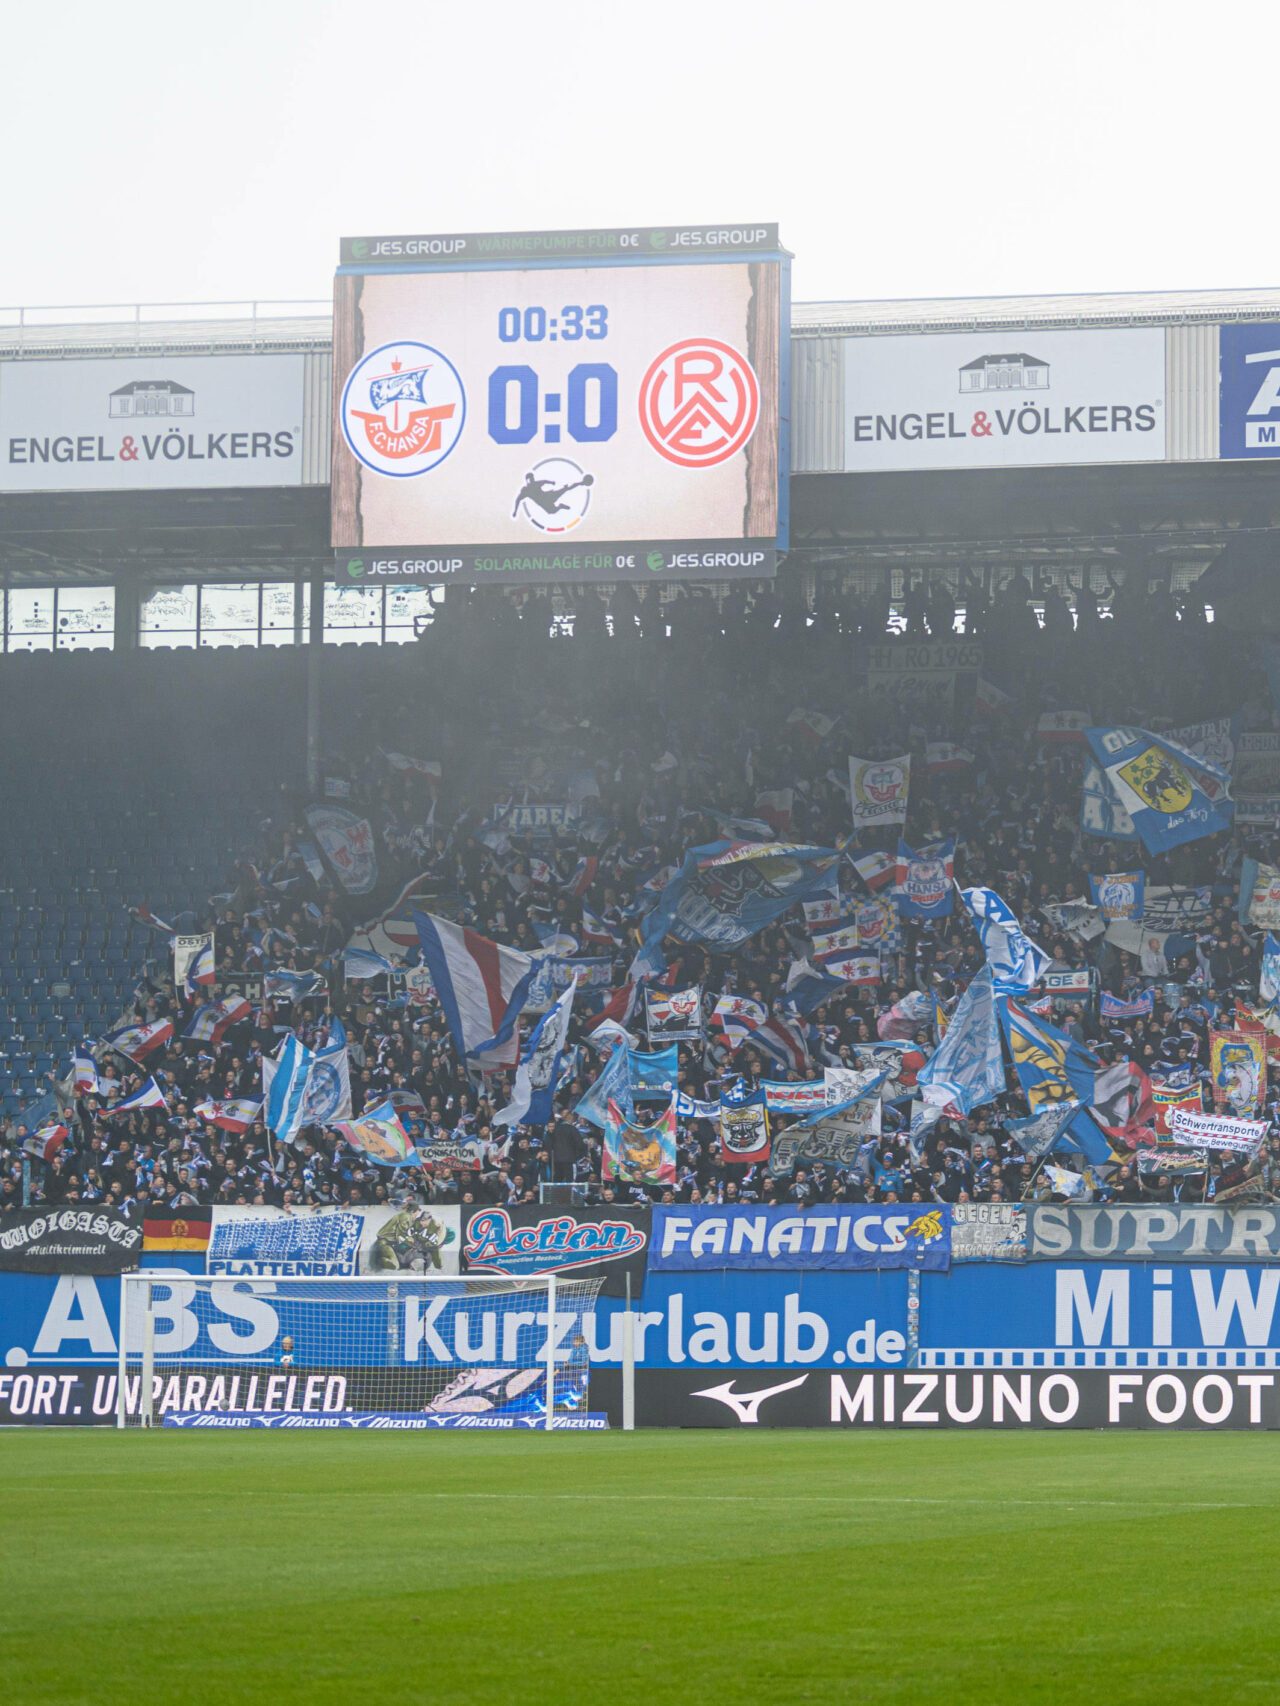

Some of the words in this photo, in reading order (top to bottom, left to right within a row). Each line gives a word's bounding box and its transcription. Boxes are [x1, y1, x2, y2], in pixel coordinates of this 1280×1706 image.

[370, 239, 467, 256] JES.GROUP
[587, 231, 617, 248] FÜR
[619, 233, 639, 248] 0€
[670, 229, 768, 247] JES.GROUP
[498, 304, 609, 343] 00:33
[488, 362, 619, 446] 0:0
[367, 558, 464, 576] JES.GROUP
[473, 555, 582, 572] SOLARANLAGE
[584, 552, 613, 569] FÜR
[615, 554, 636, 569] 0€
[666, 551, 765, 569] JES.GROUP
[1175, 1113, 1261, 1137] Schwertransporte
[1196, 1136, 1209, 1146] der
[954, 1204, 1013, 1225] GEGEN
[25, 1244, 106, 1256] Multikriminell
[466, 1208, 645, 1262] Action
[661, 1213, 912, 1257] FANATICS
[210, 1261, 353, 1276] PLATTENBAU
[403, 1292, 904, 1364] Kurzurlaub.de
[92, 1374, 354, 1416] UNPARALLELED.
[830, 1373, 1081, 1423] MIZUNO
